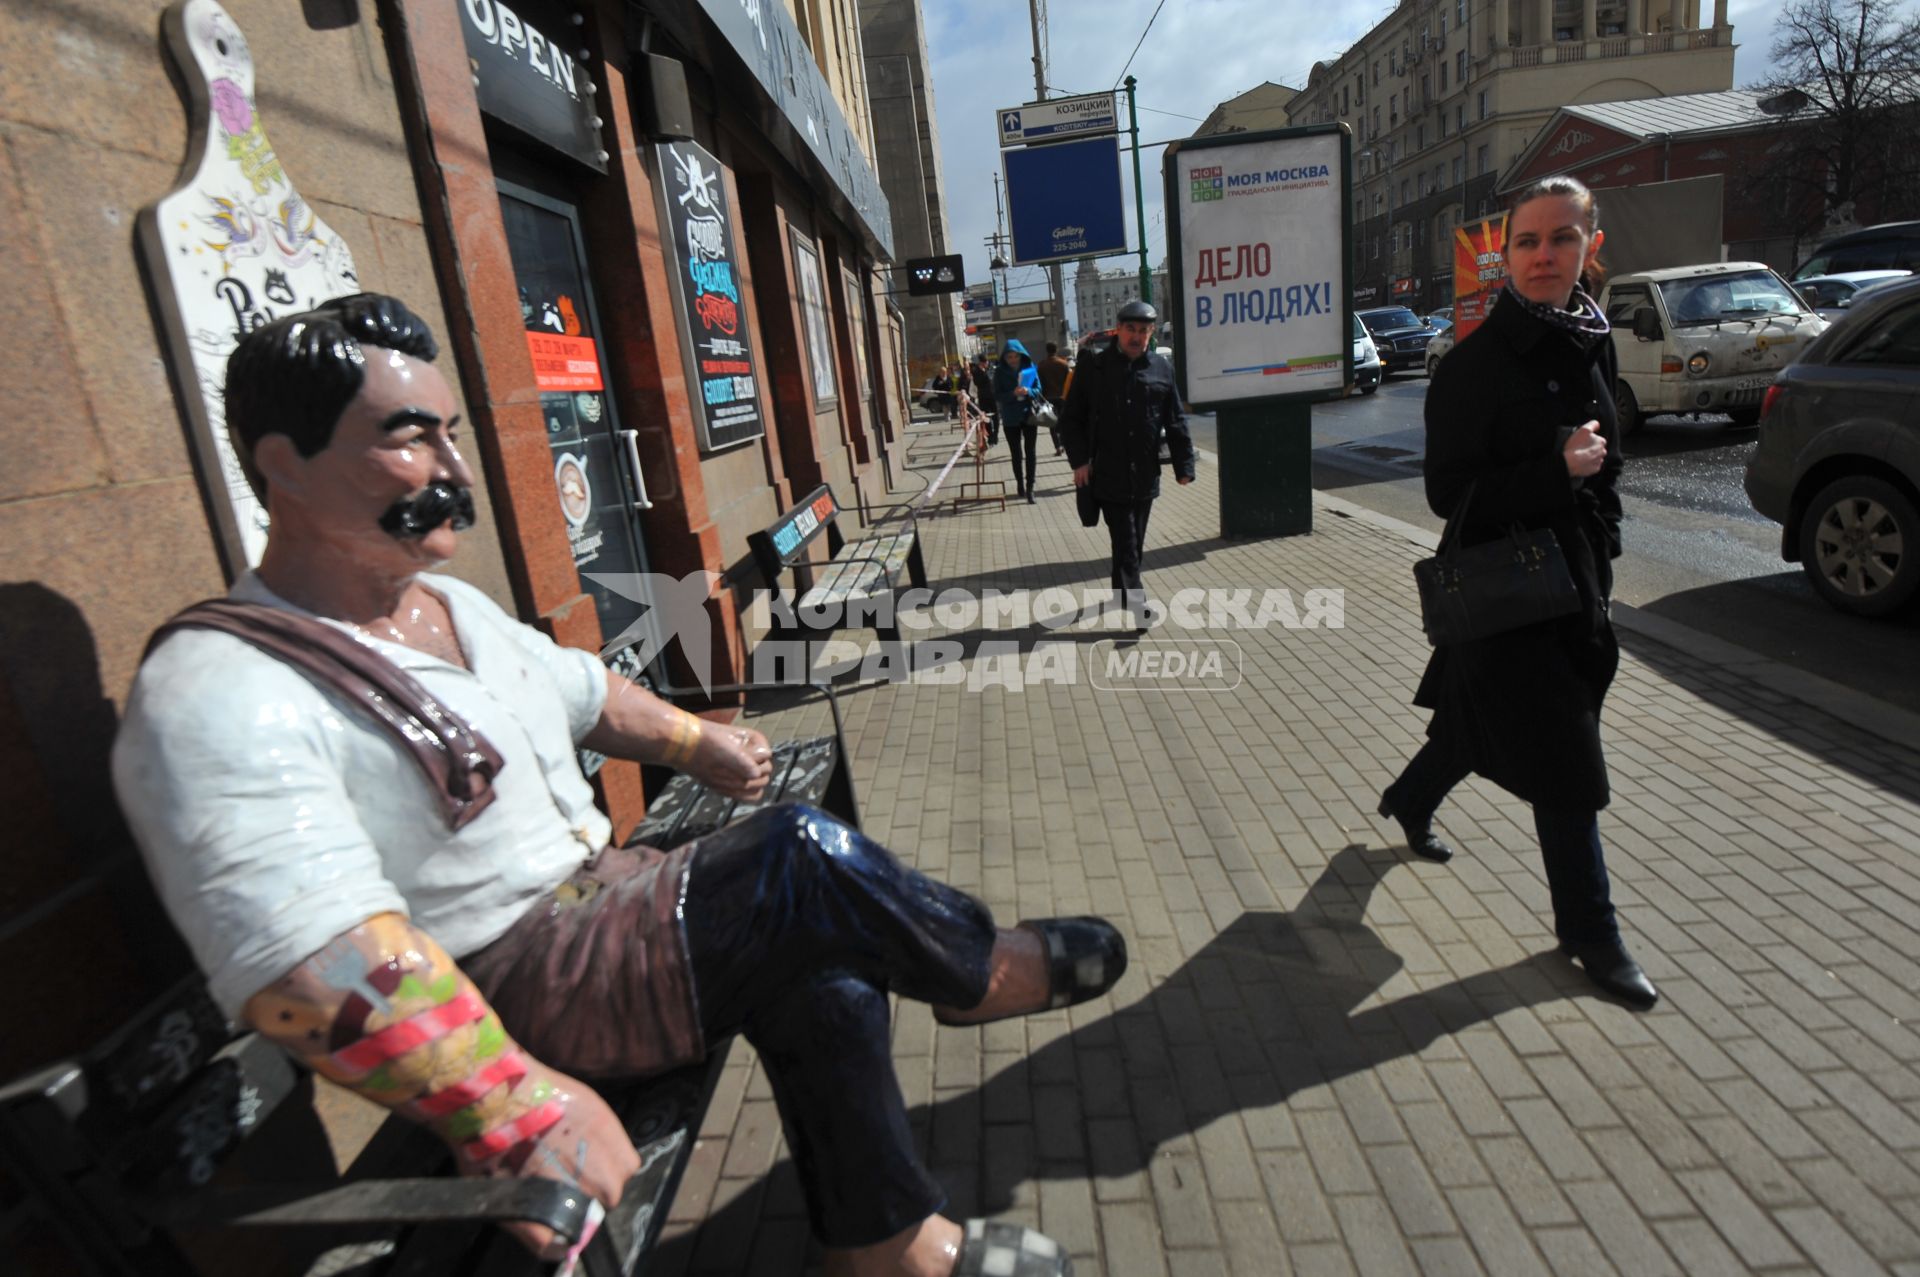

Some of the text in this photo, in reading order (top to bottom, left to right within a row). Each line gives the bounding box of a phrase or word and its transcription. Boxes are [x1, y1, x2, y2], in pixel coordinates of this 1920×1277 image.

[464, 0, 580, 100] OPEN
[1056, 98, 1110, 115] КОЗИЦКИЙ
[1227, 165, 1329, 187] МОЯ МОСКВА
[1227, 180, 1329, 197] ГРАЖДАНСКАЯ ИНИЦИАТИВА
[1052, 226, 1085, 239] Gallery
[1053, 240, 1087, 252] 225-2040
[1195, 242, 1272, 289] ДЕЛО
[1195, 282, 1332, 328] В ЛЮДЯХ!
